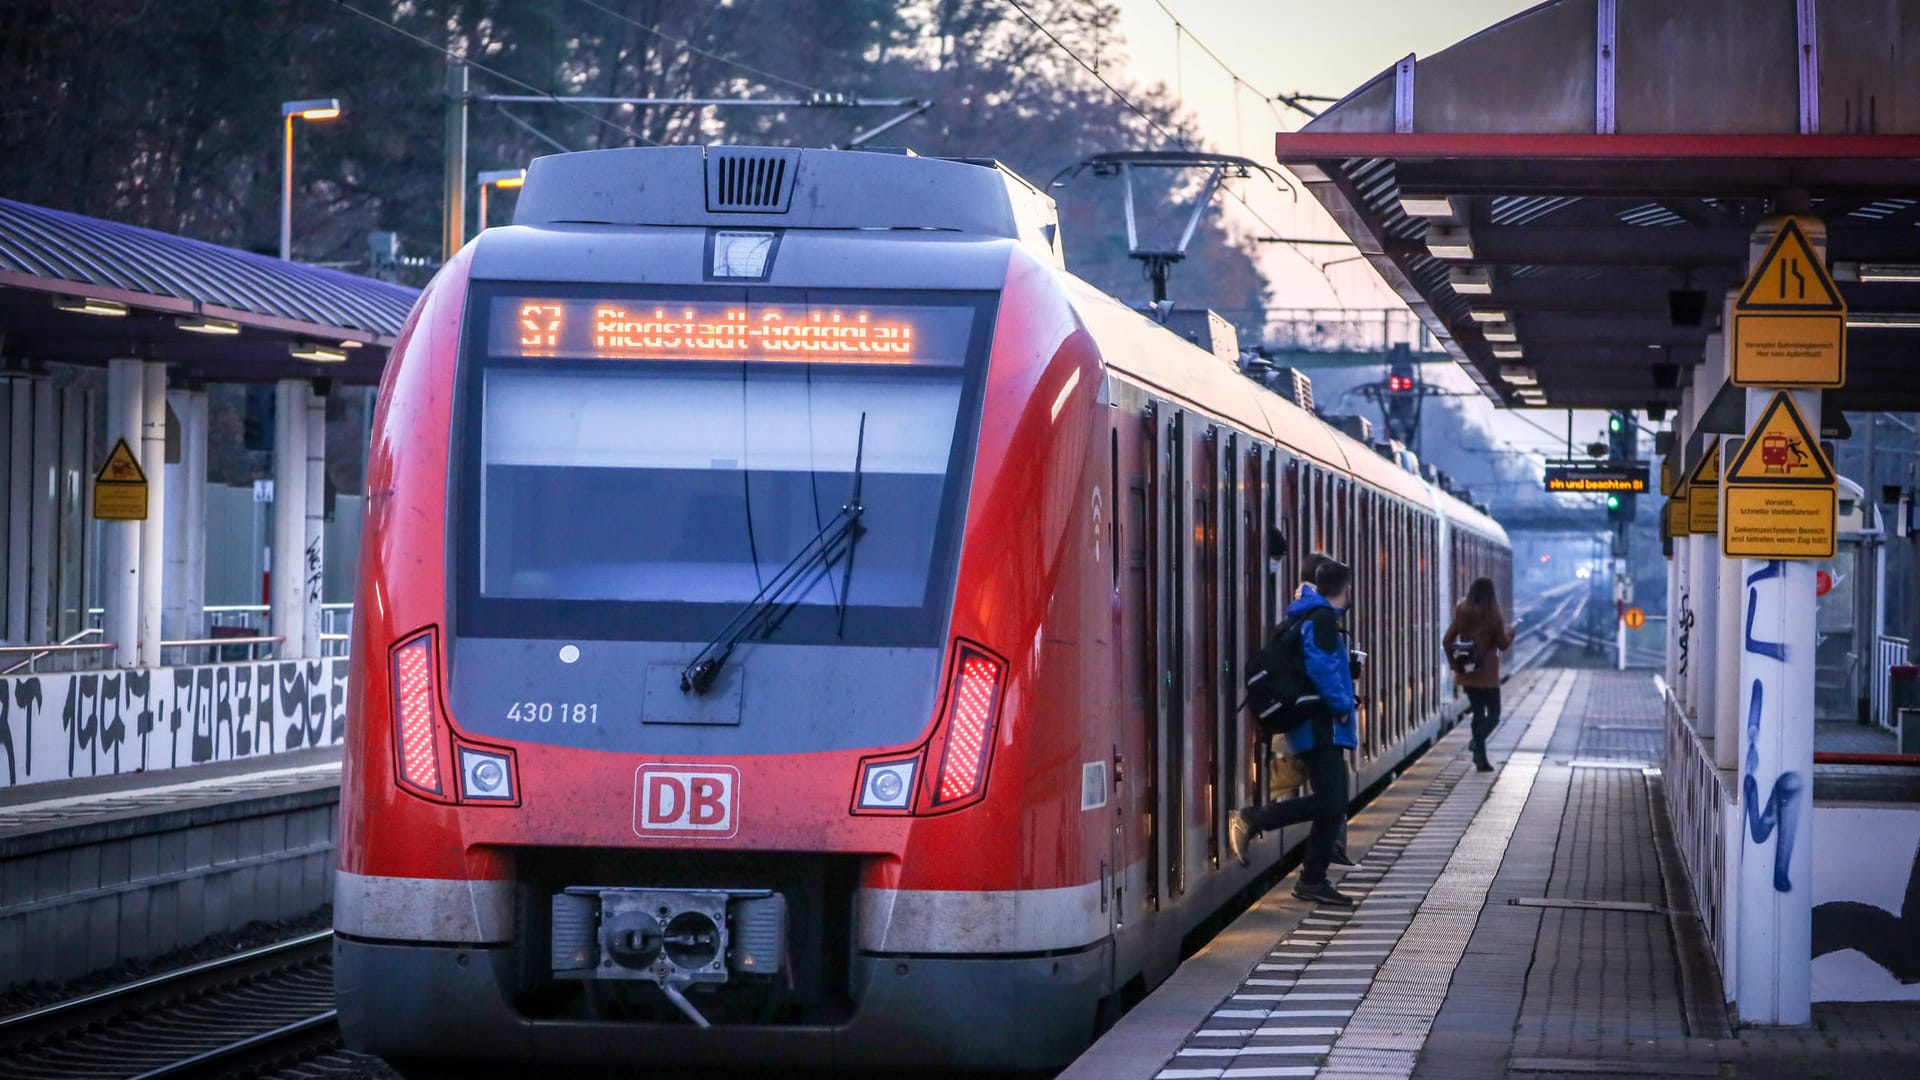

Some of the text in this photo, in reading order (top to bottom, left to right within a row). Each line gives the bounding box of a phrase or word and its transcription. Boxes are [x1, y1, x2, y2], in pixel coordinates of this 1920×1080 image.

[520, 304, 912, 354] S7 Riedstadt-Goddelau
[1565, 479, 1584, 489] und
[1585, 479, 1631, 490] beachten
[171, 664, 275, 769] FORZA
[507, 702, 599, 724] 430 181
[647, 775, 727, 826] DB
